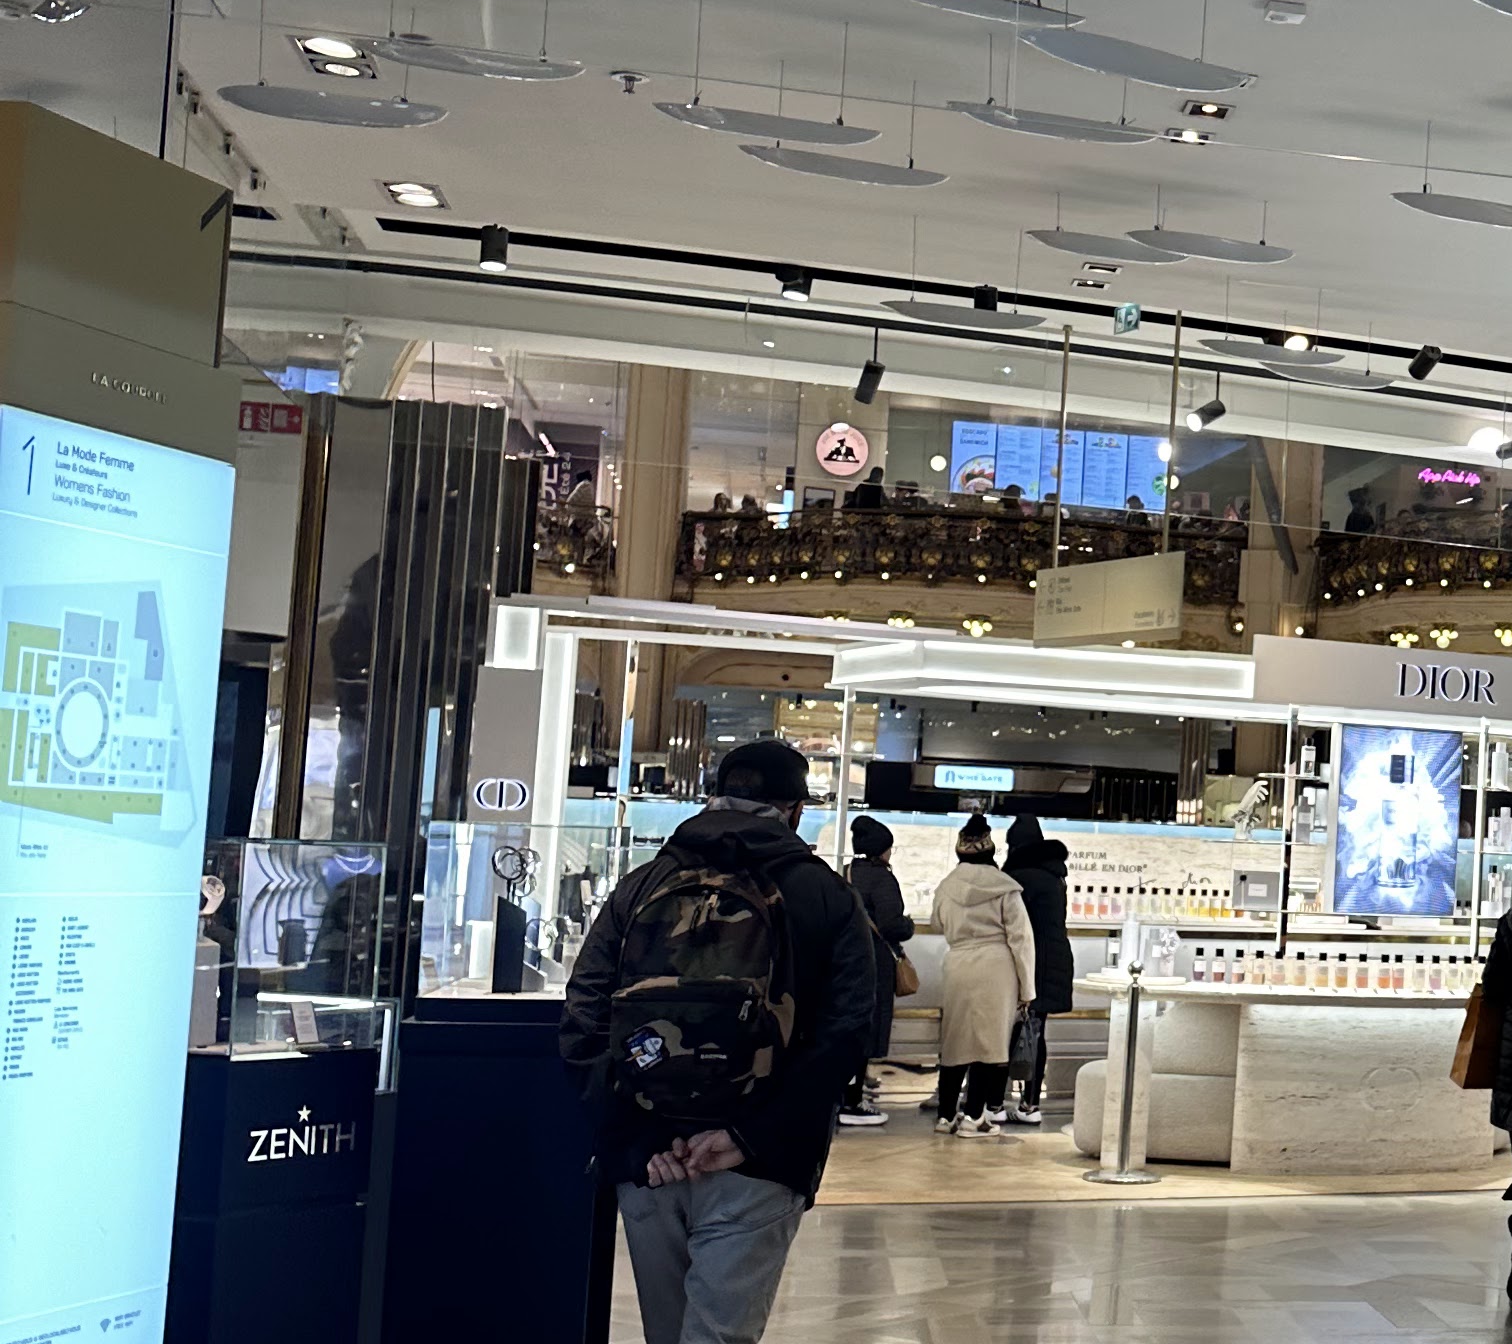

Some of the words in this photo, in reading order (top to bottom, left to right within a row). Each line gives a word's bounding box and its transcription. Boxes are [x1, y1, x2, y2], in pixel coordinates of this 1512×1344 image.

[22, 435, 36, 496] 1
[57, 441, 69, 456] La
[72, 445, 97, 463] Mode
[99, 452, 135, 472] Femme
[97, 484, 130, 503] Fashion
[1394, 661, 1498, 706] DIOR
[247, 1121, 356, 1162] ZENITH
